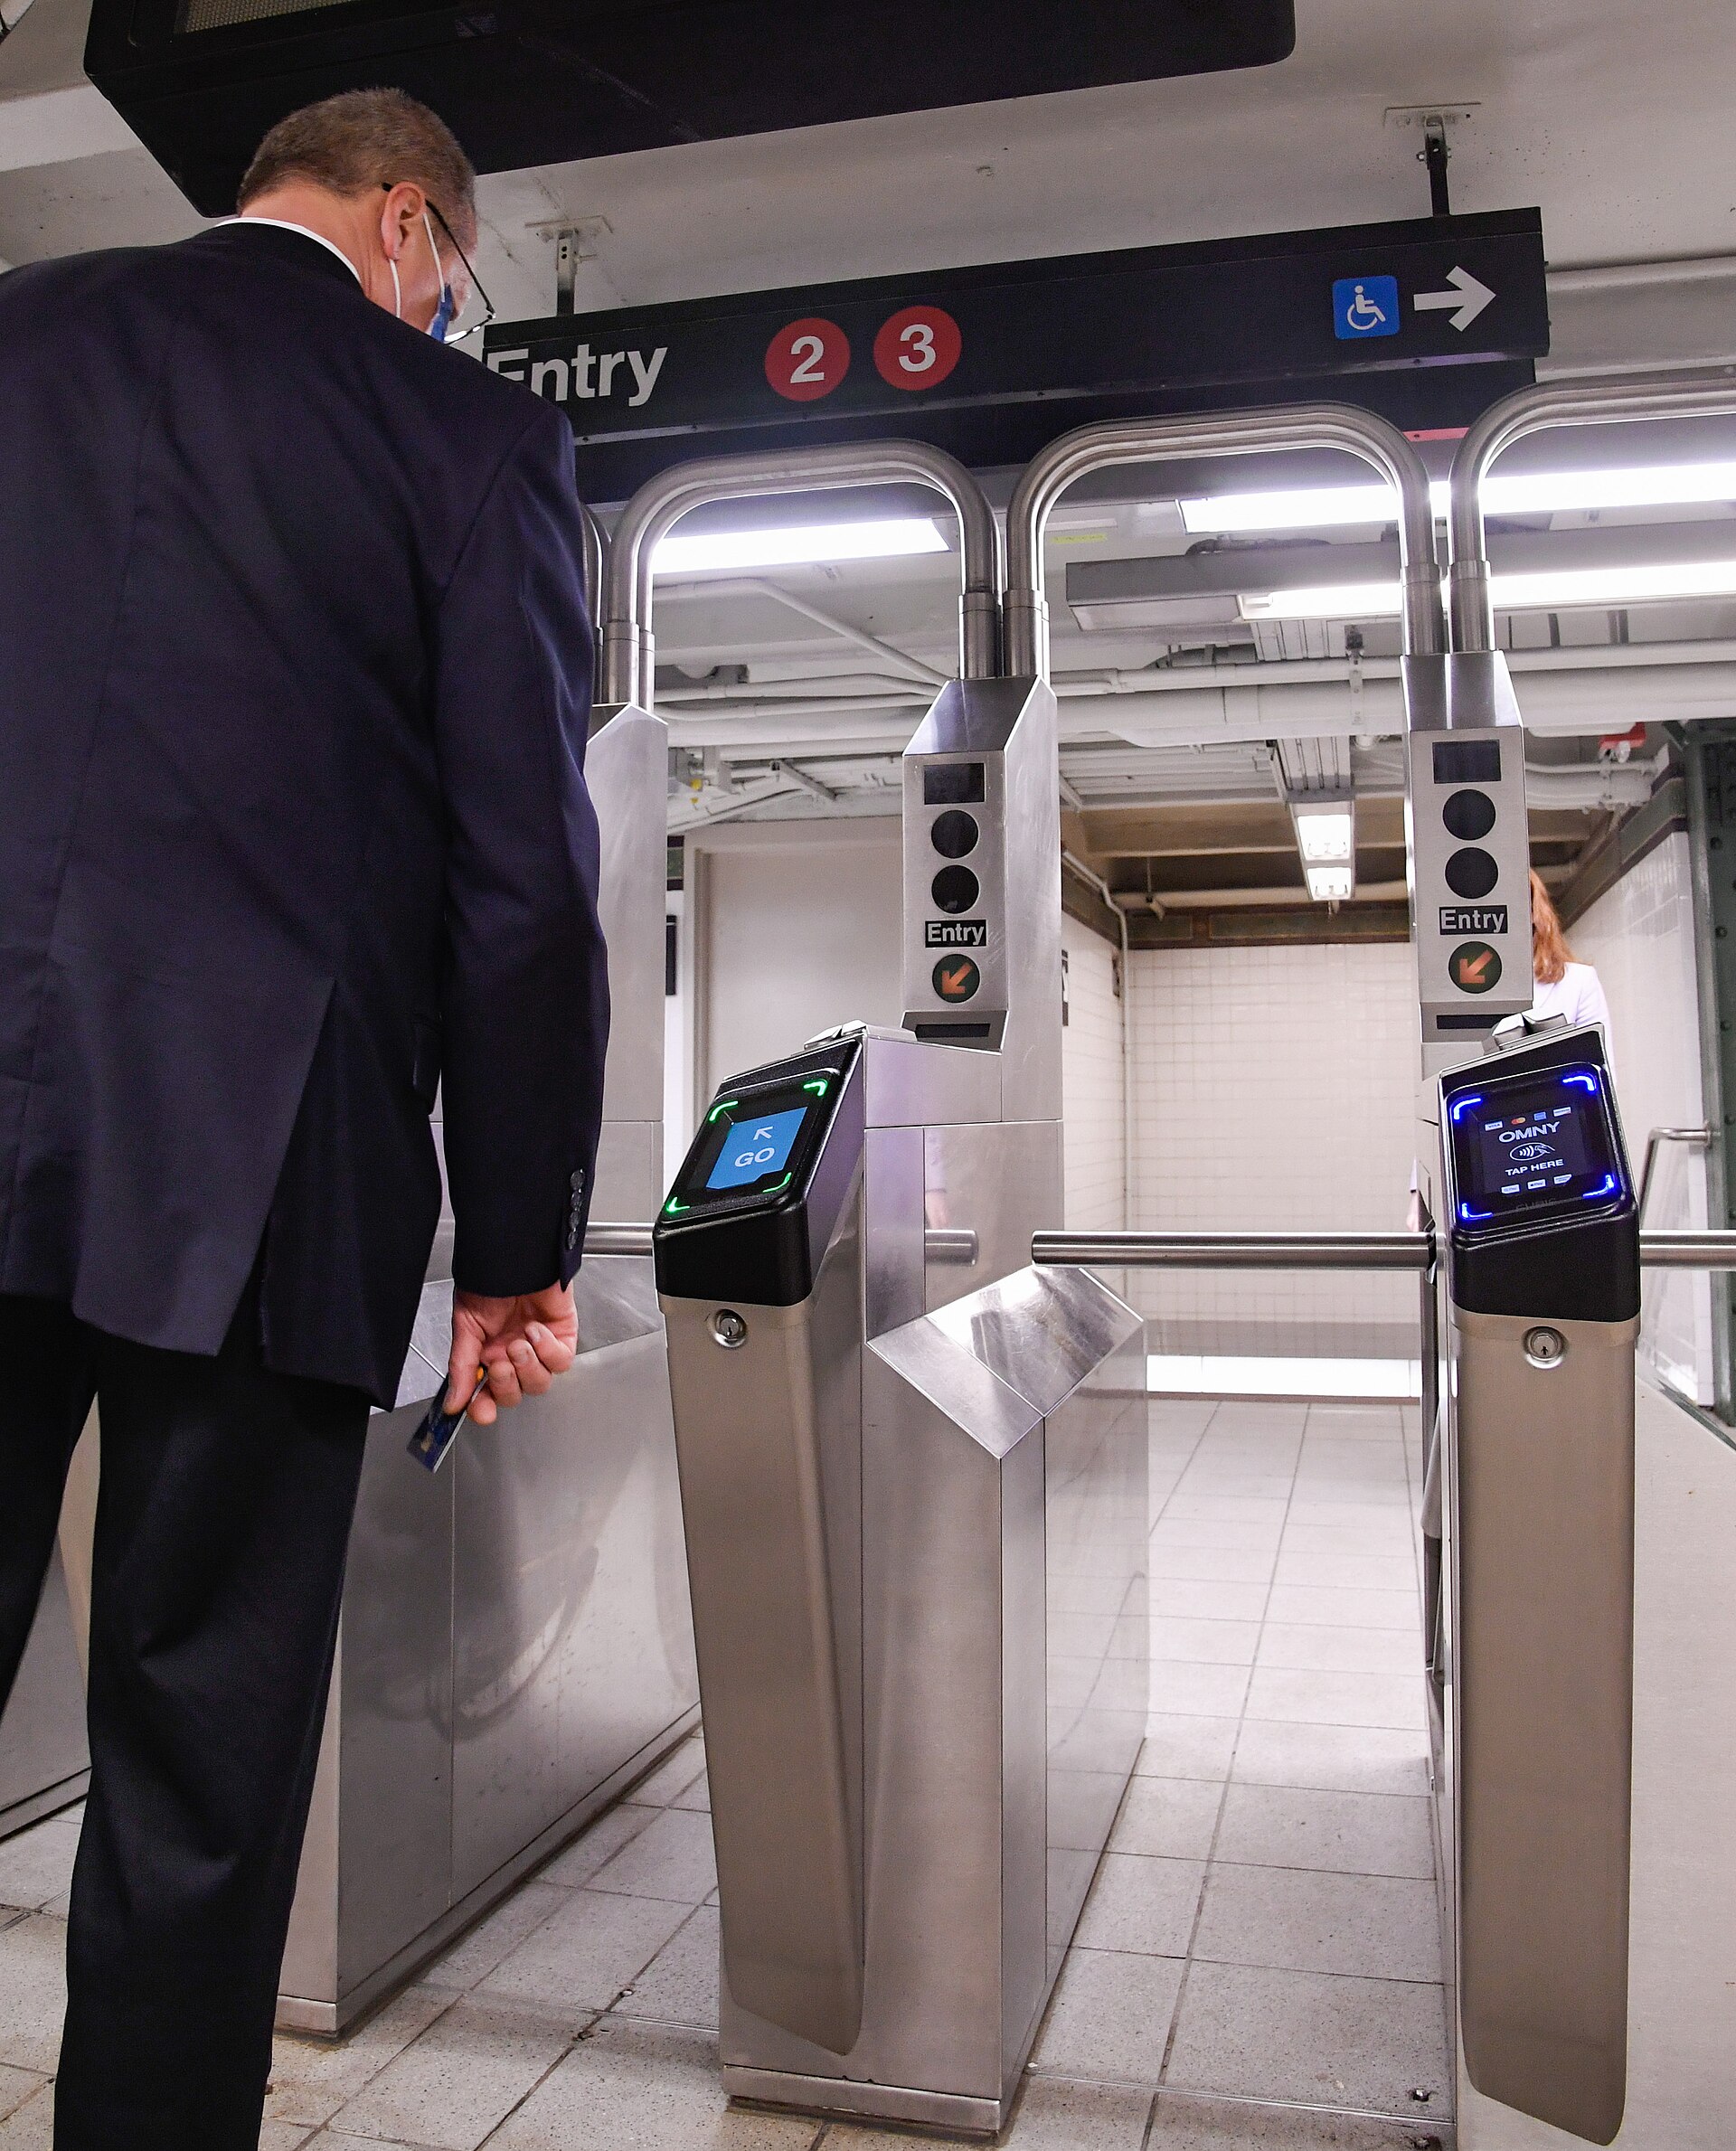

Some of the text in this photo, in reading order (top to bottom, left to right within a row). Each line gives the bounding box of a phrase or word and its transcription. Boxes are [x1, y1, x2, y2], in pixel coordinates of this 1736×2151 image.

[789, 335, 826, 383] 2
[899, 324, 936, 372] 3
[1440, 909, 1505, 933] Entry
[928, 923, 985, 946] Entry
[1498, 1121, 1560, 1143] OMNY
[734, 1147, 775, 1167] GO
[1505, 1158, 1564, 1176] TAP HERE
